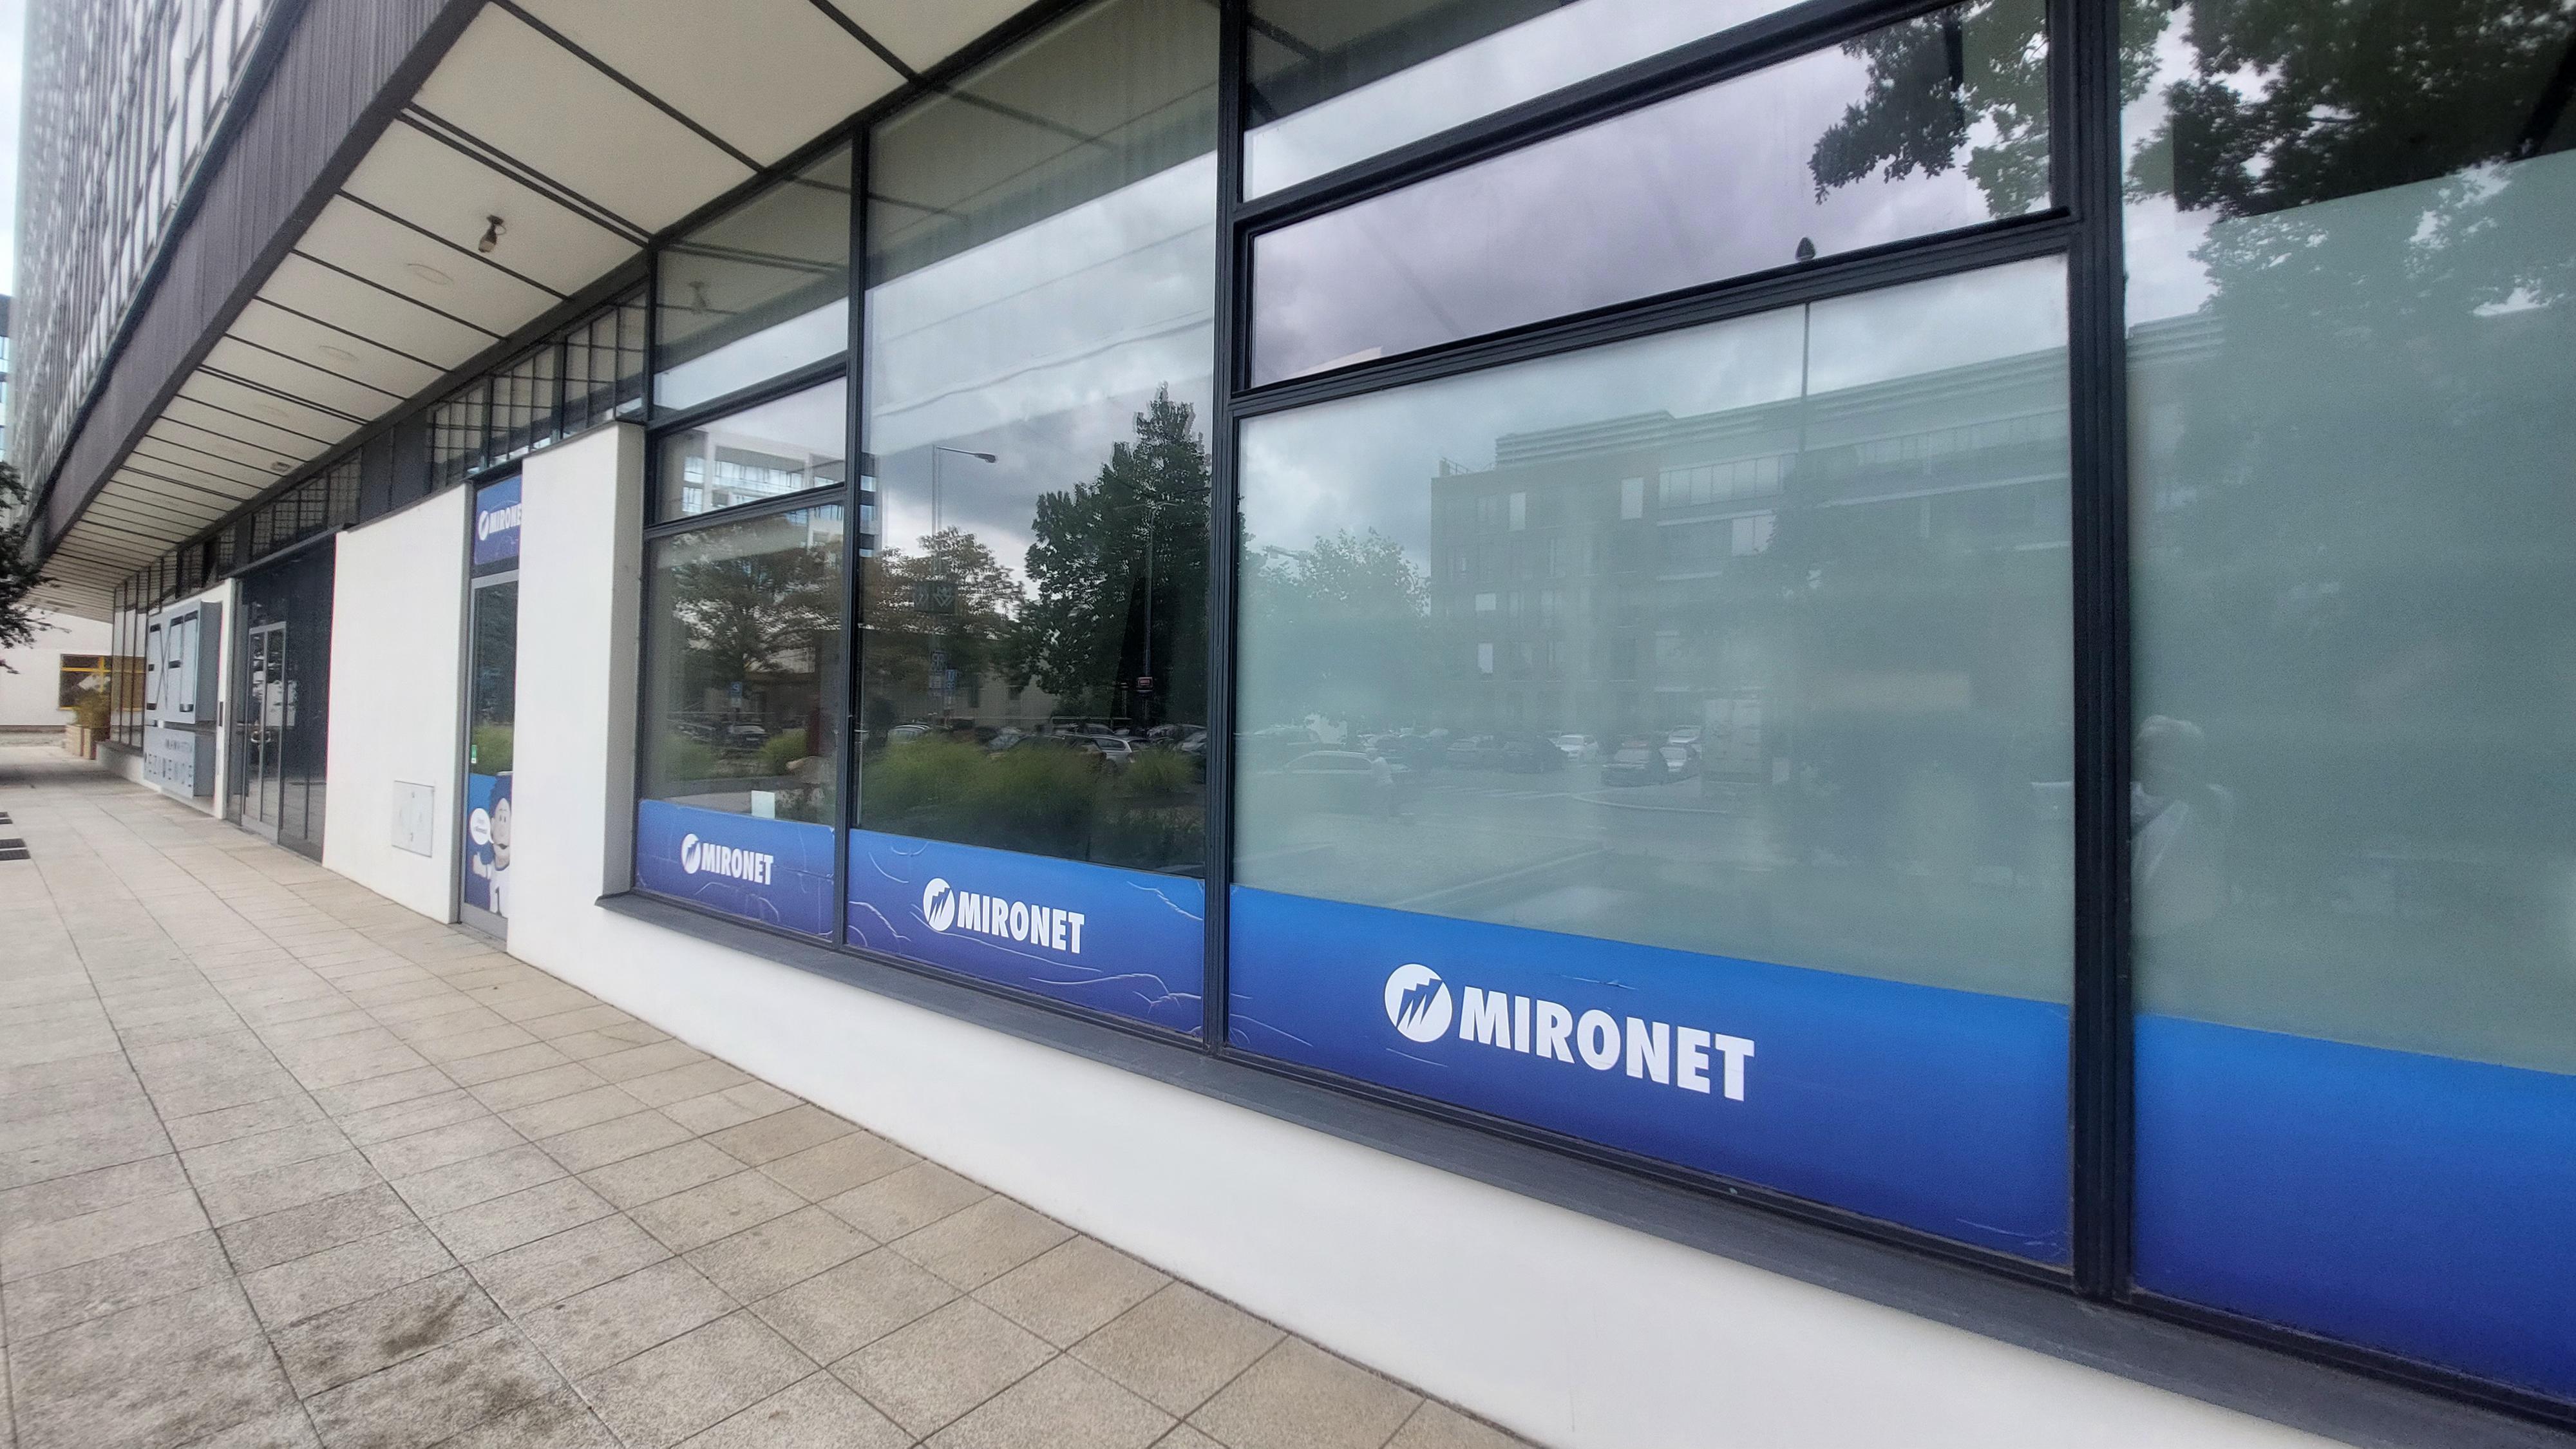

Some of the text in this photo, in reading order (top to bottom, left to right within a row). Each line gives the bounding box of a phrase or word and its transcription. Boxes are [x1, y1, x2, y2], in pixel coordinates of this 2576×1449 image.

[700, 842, 774, 886] MIRONET
[957, 891, 1085, 954] MIRONET
[1459, 985, 1755, 1102] MIRONET
